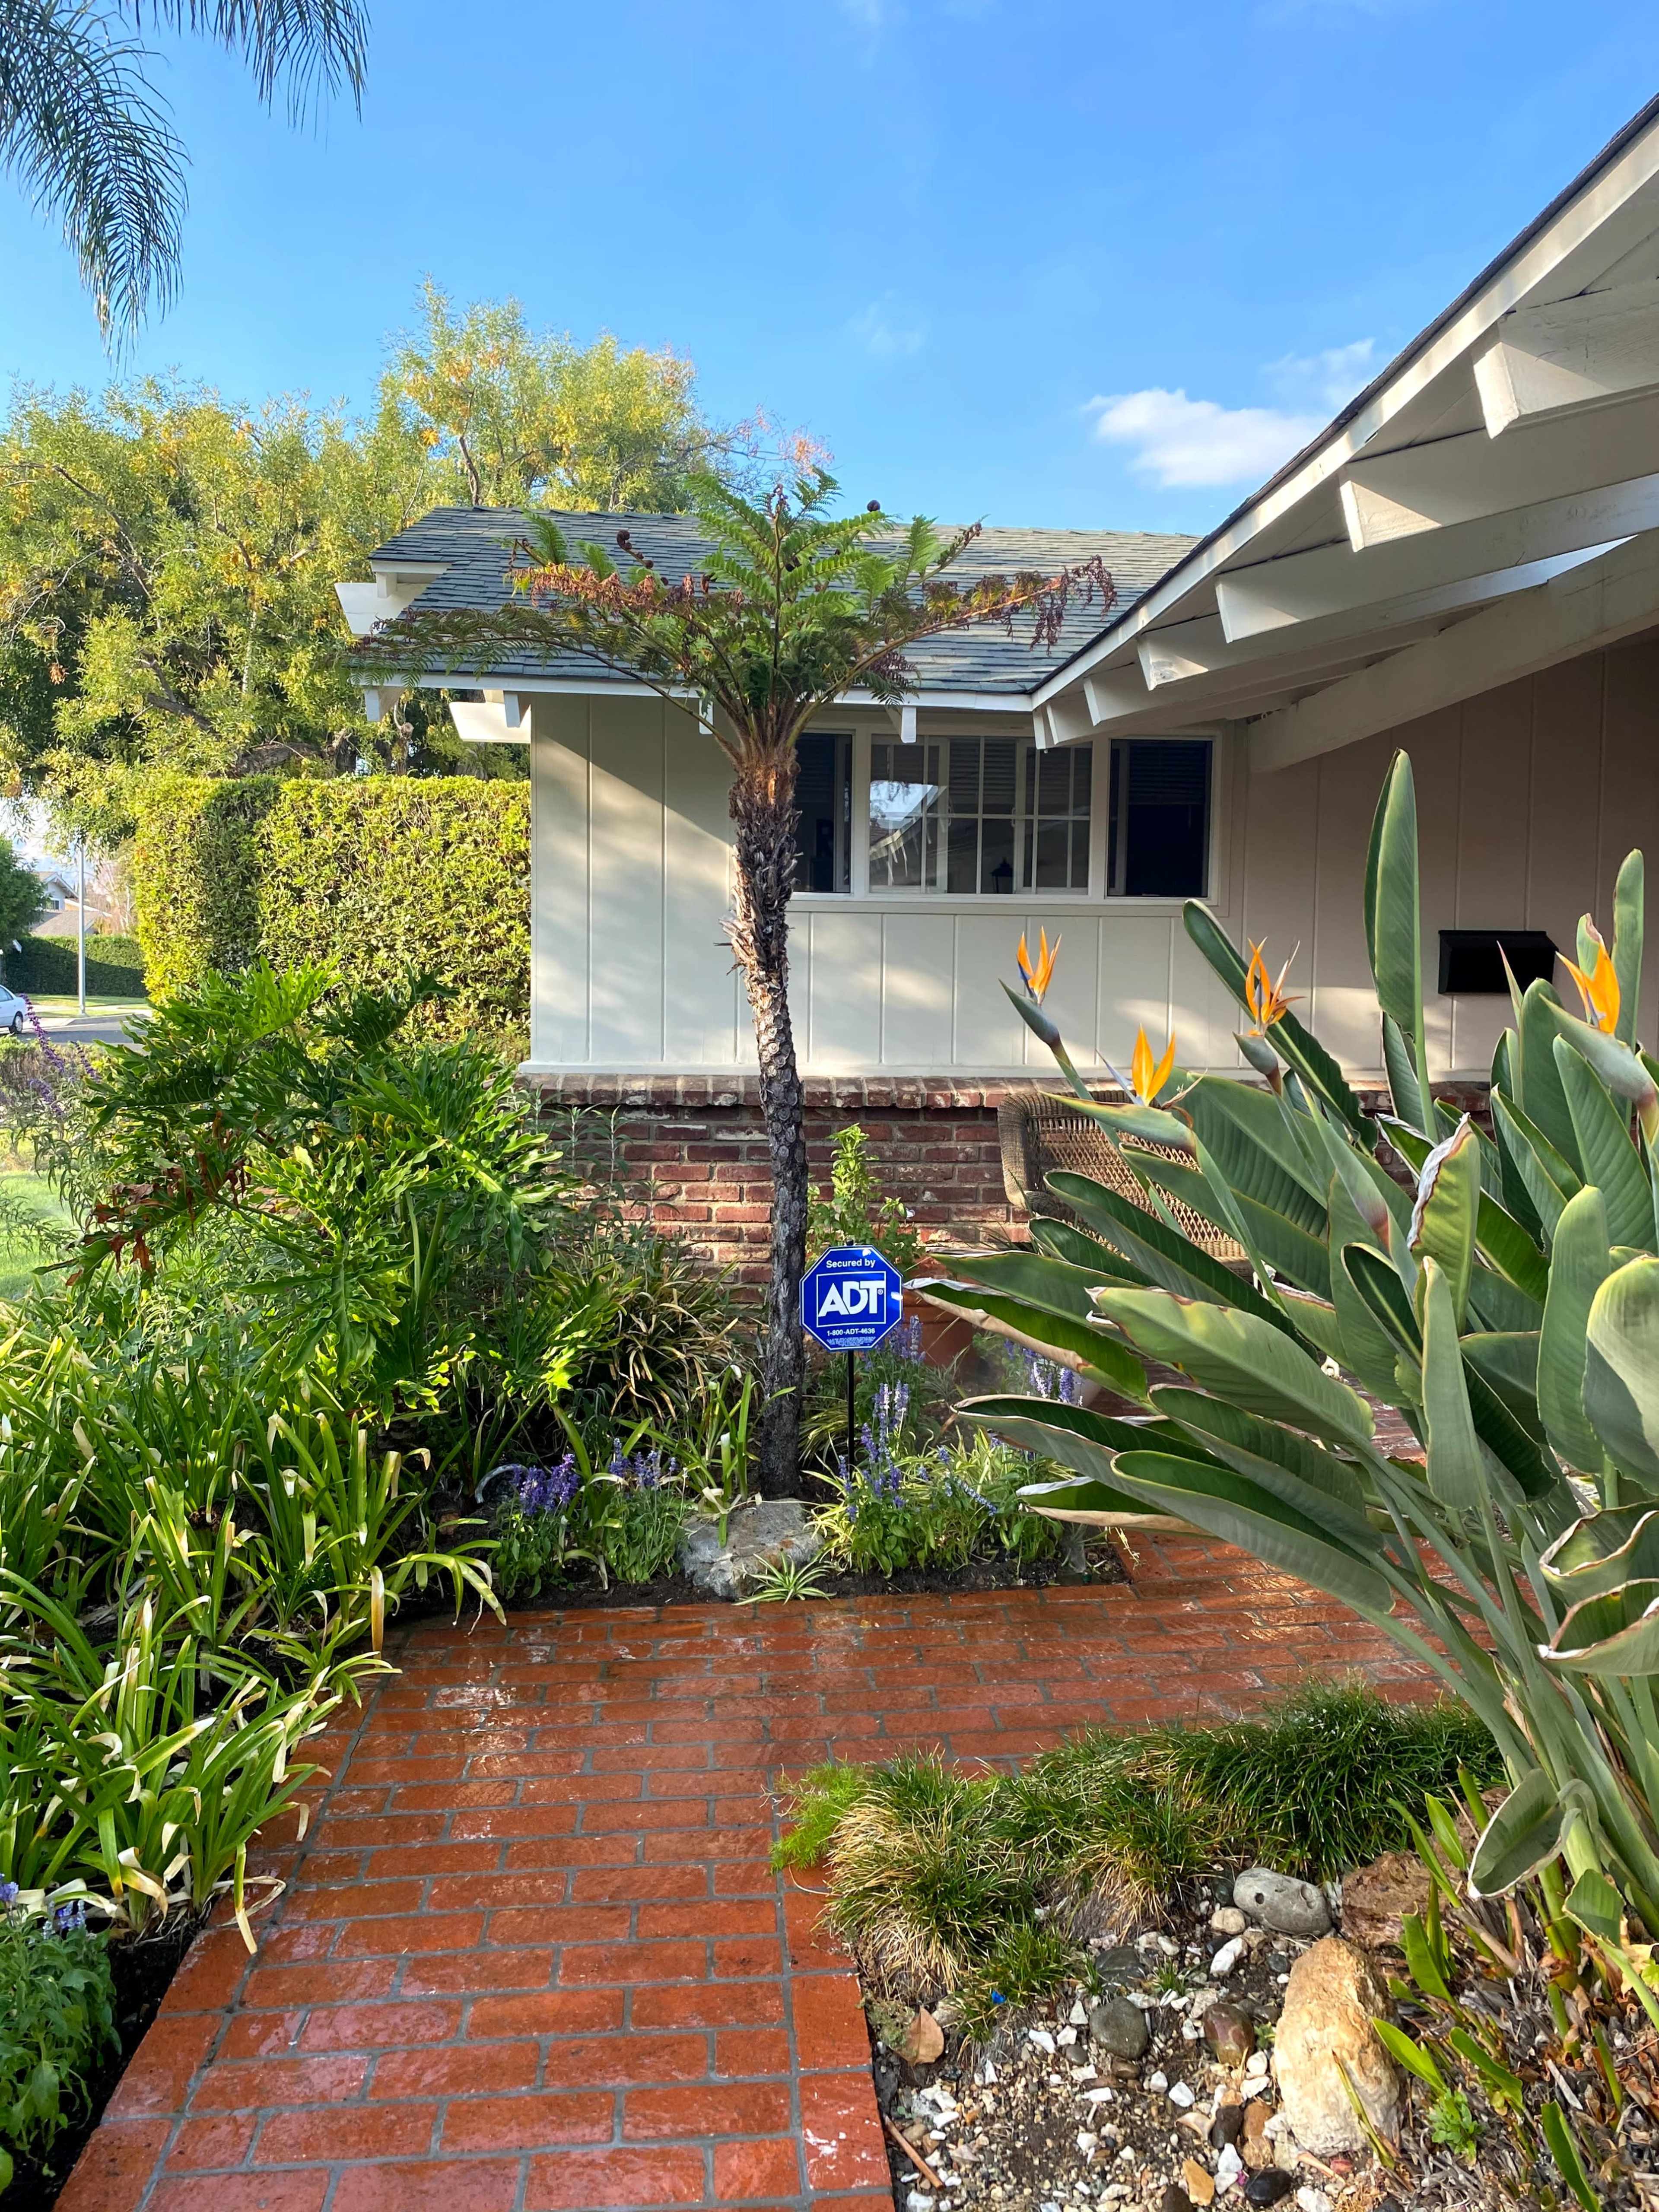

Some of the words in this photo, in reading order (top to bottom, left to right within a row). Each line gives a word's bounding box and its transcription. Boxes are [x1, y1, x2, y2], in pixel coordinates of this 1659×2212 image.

[826, 1259, 862, 1268] Secured
[864, 1259, 876, 1268] by
[818, 1281, 886, 1317] ADT
[827, 1328, 875, 1336] 1-800-ADT-4636
